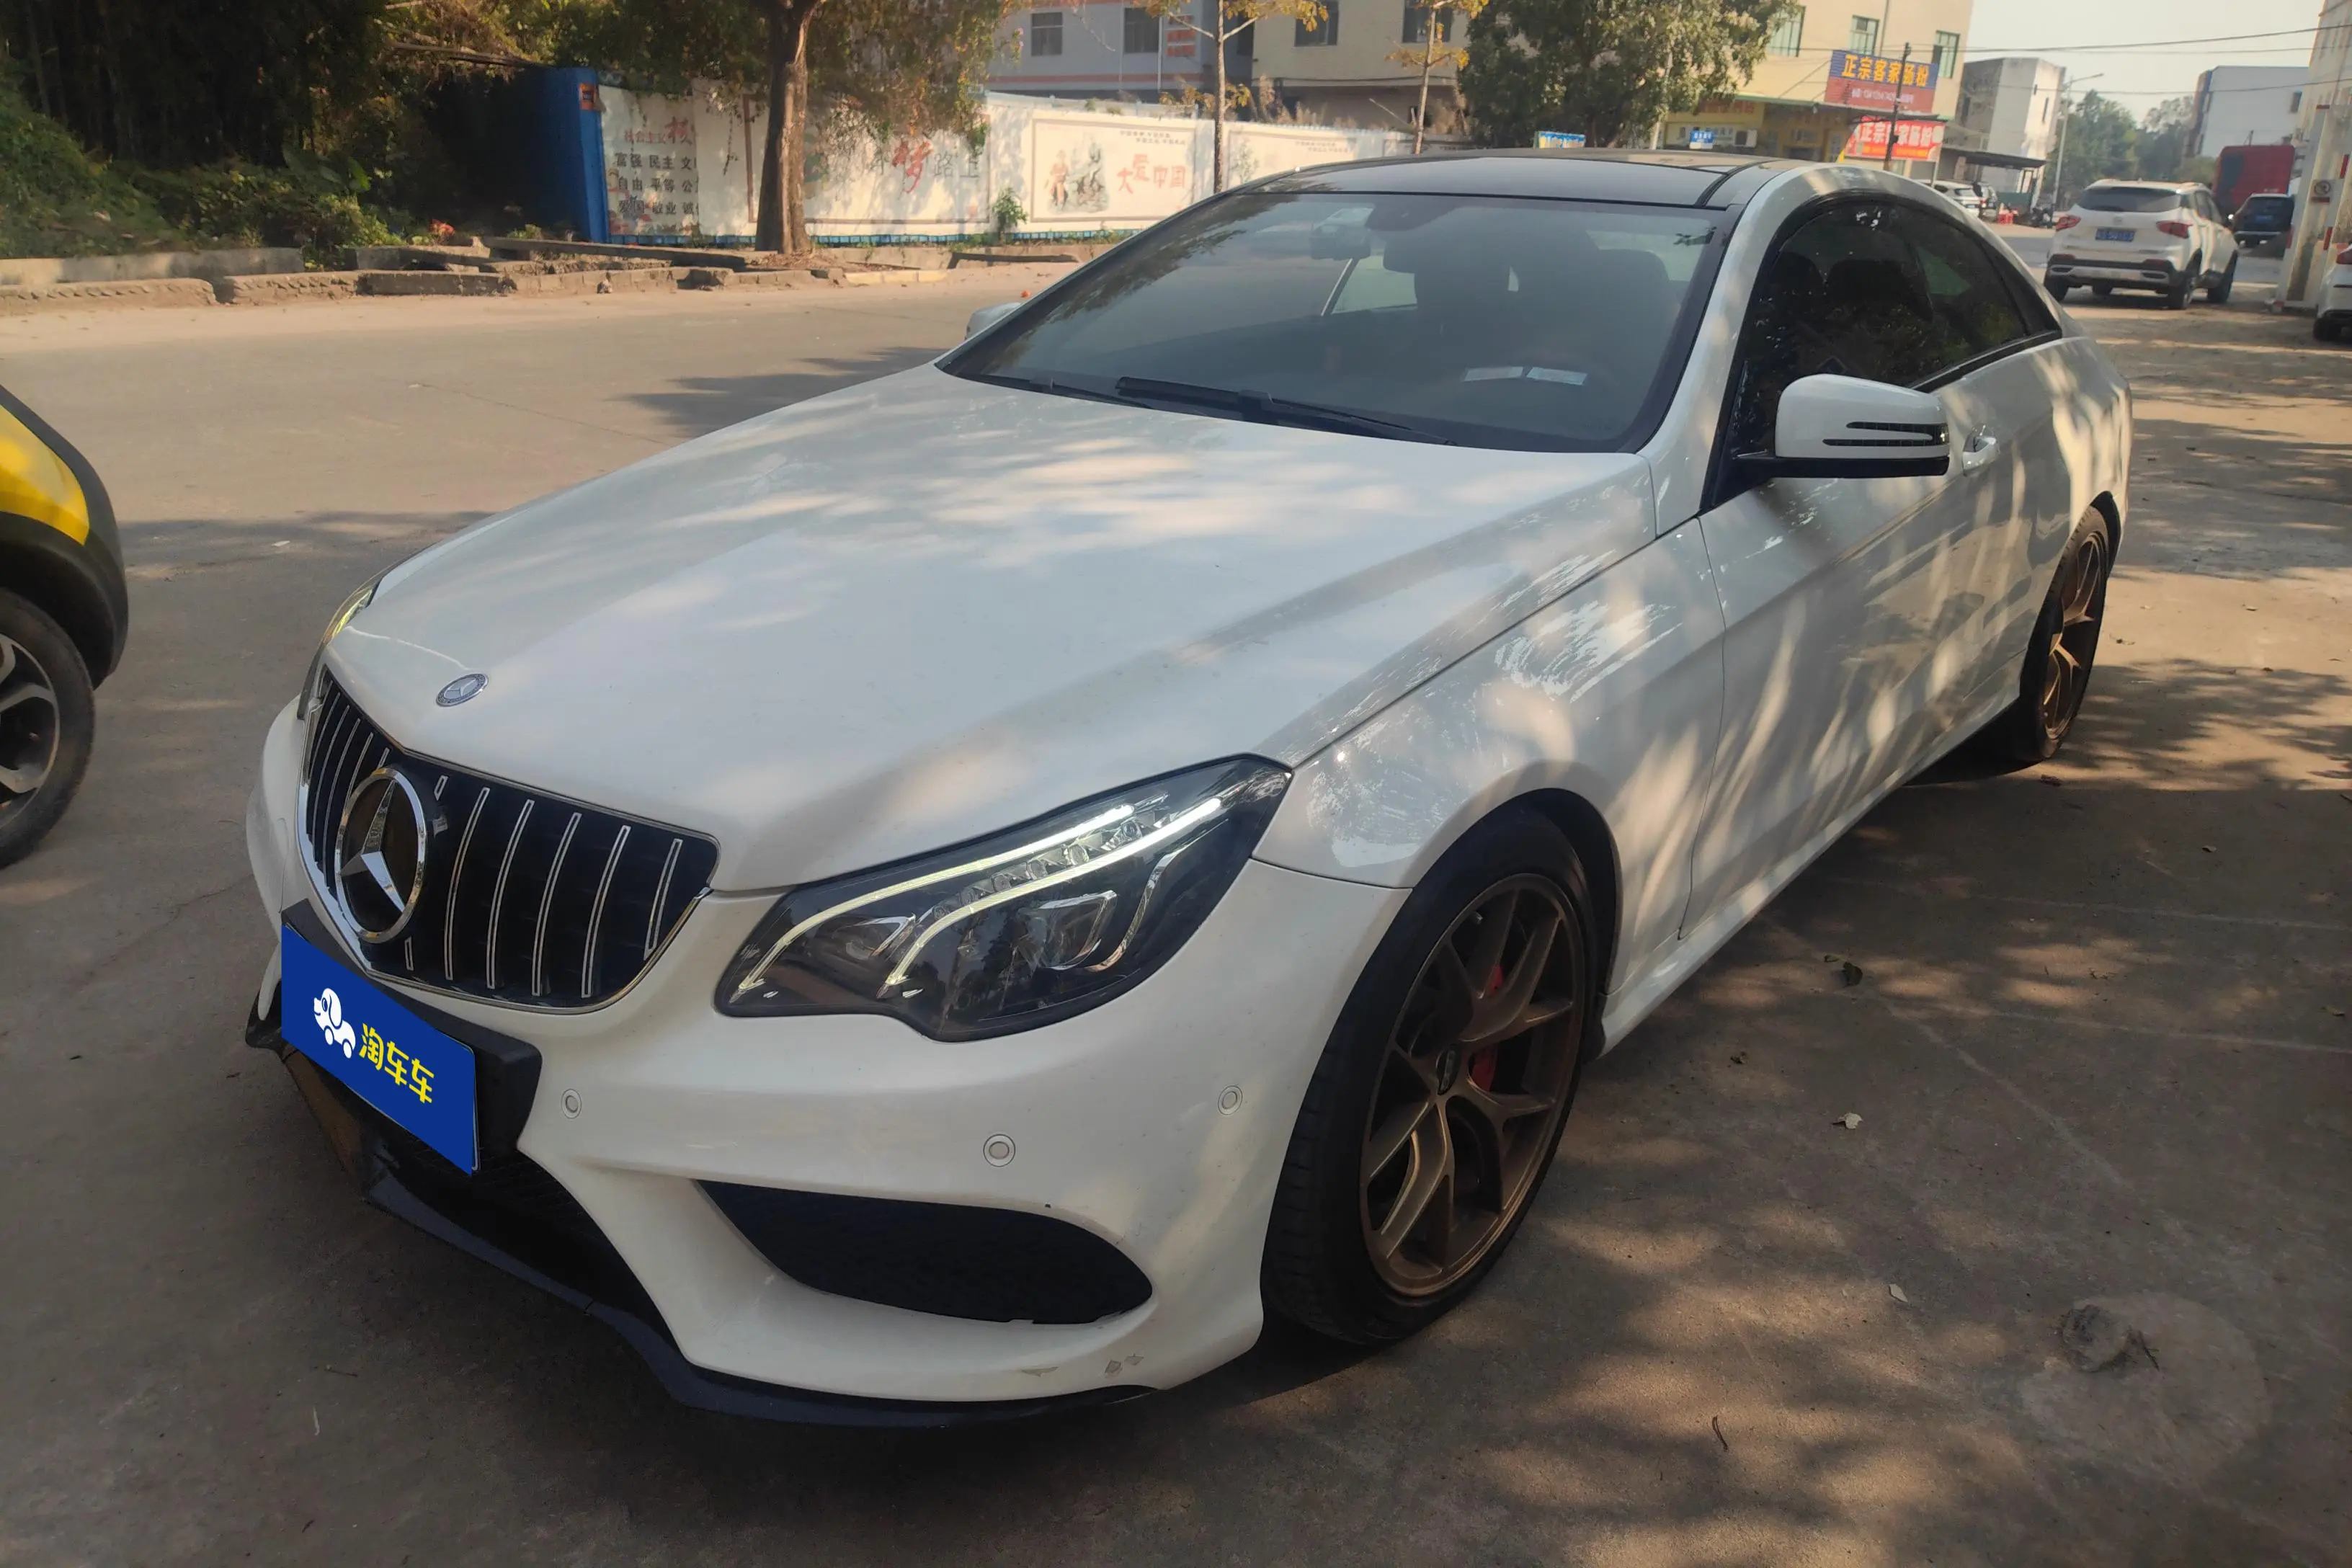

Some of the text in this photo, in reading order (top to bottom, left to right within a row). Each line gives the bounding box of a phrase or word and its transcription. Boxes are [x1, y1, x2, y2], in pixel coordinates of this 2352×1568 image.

[624, 116, 696, 146] 社会主义核
[649, 154, 674, 169] 民主
[681, 156, 697, 171] 文
[619, 176, 643, 191] 自由
[650, 177, 675, 193] 平等
[652, 201, 677, 215] 敬业
[682, 201, 699, 215] 诚
